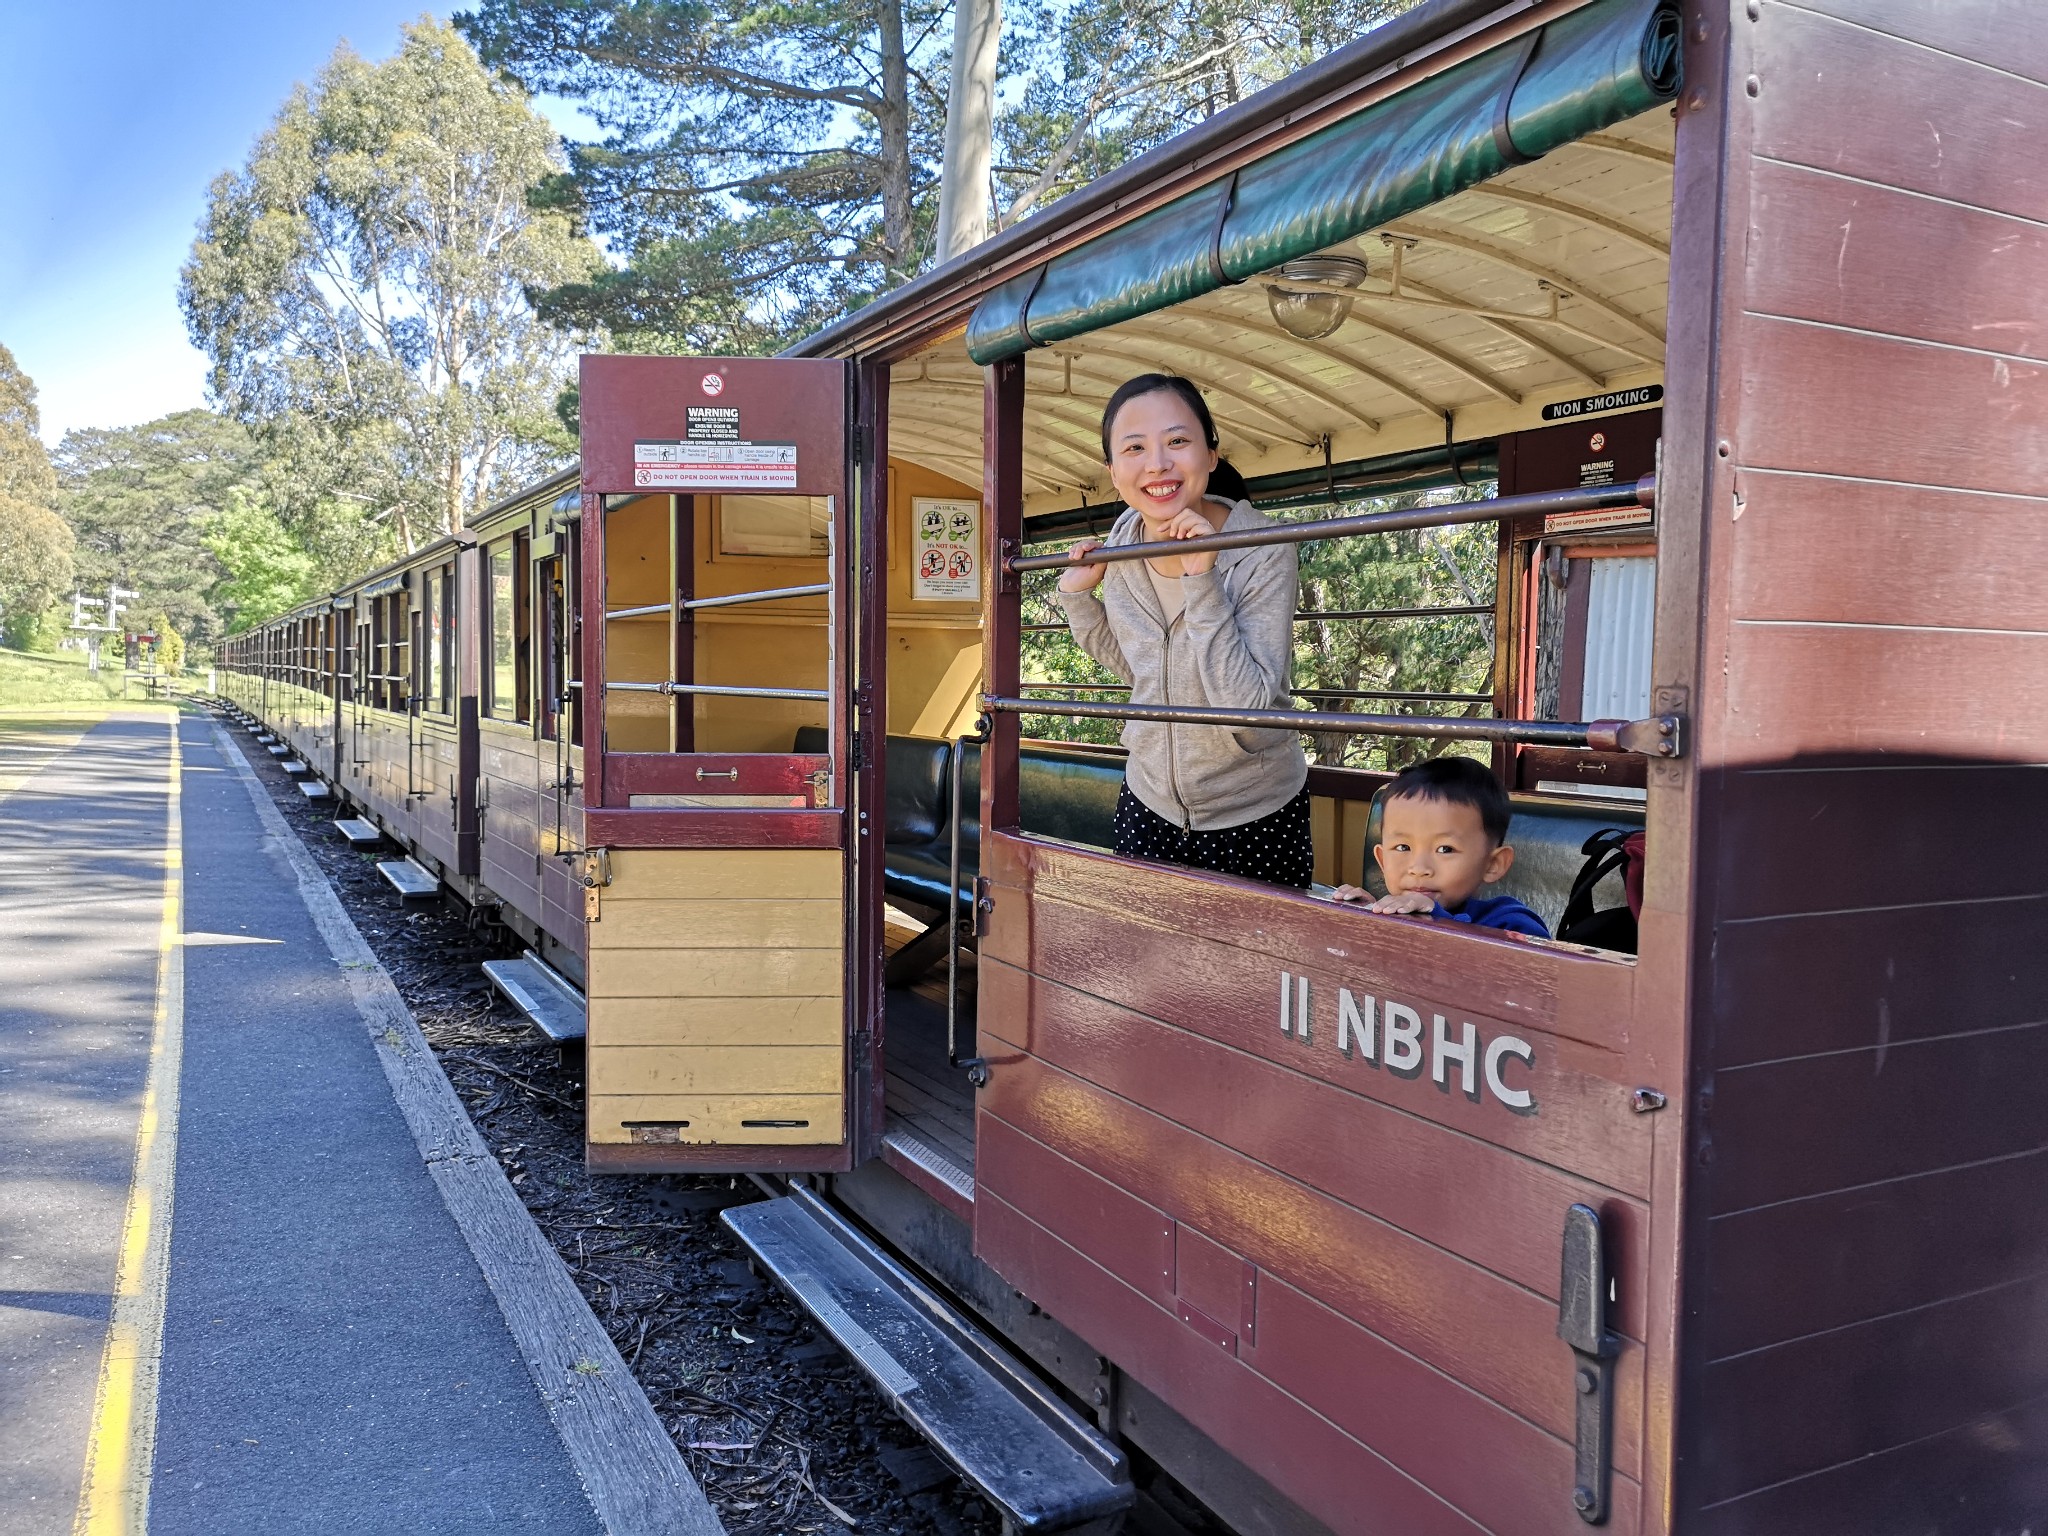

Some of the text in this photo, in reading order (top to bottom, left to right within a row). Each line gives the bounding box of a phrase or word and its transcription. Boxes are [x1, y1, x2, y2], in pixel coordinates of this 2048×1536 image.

[688, 408, 738, 417] WARNING
[1553, 389, 1650, 417] NON SMOKING
[1581, 460, 1614, 471] WARNING
[1337, 987, 1533, 1110] NBHC
